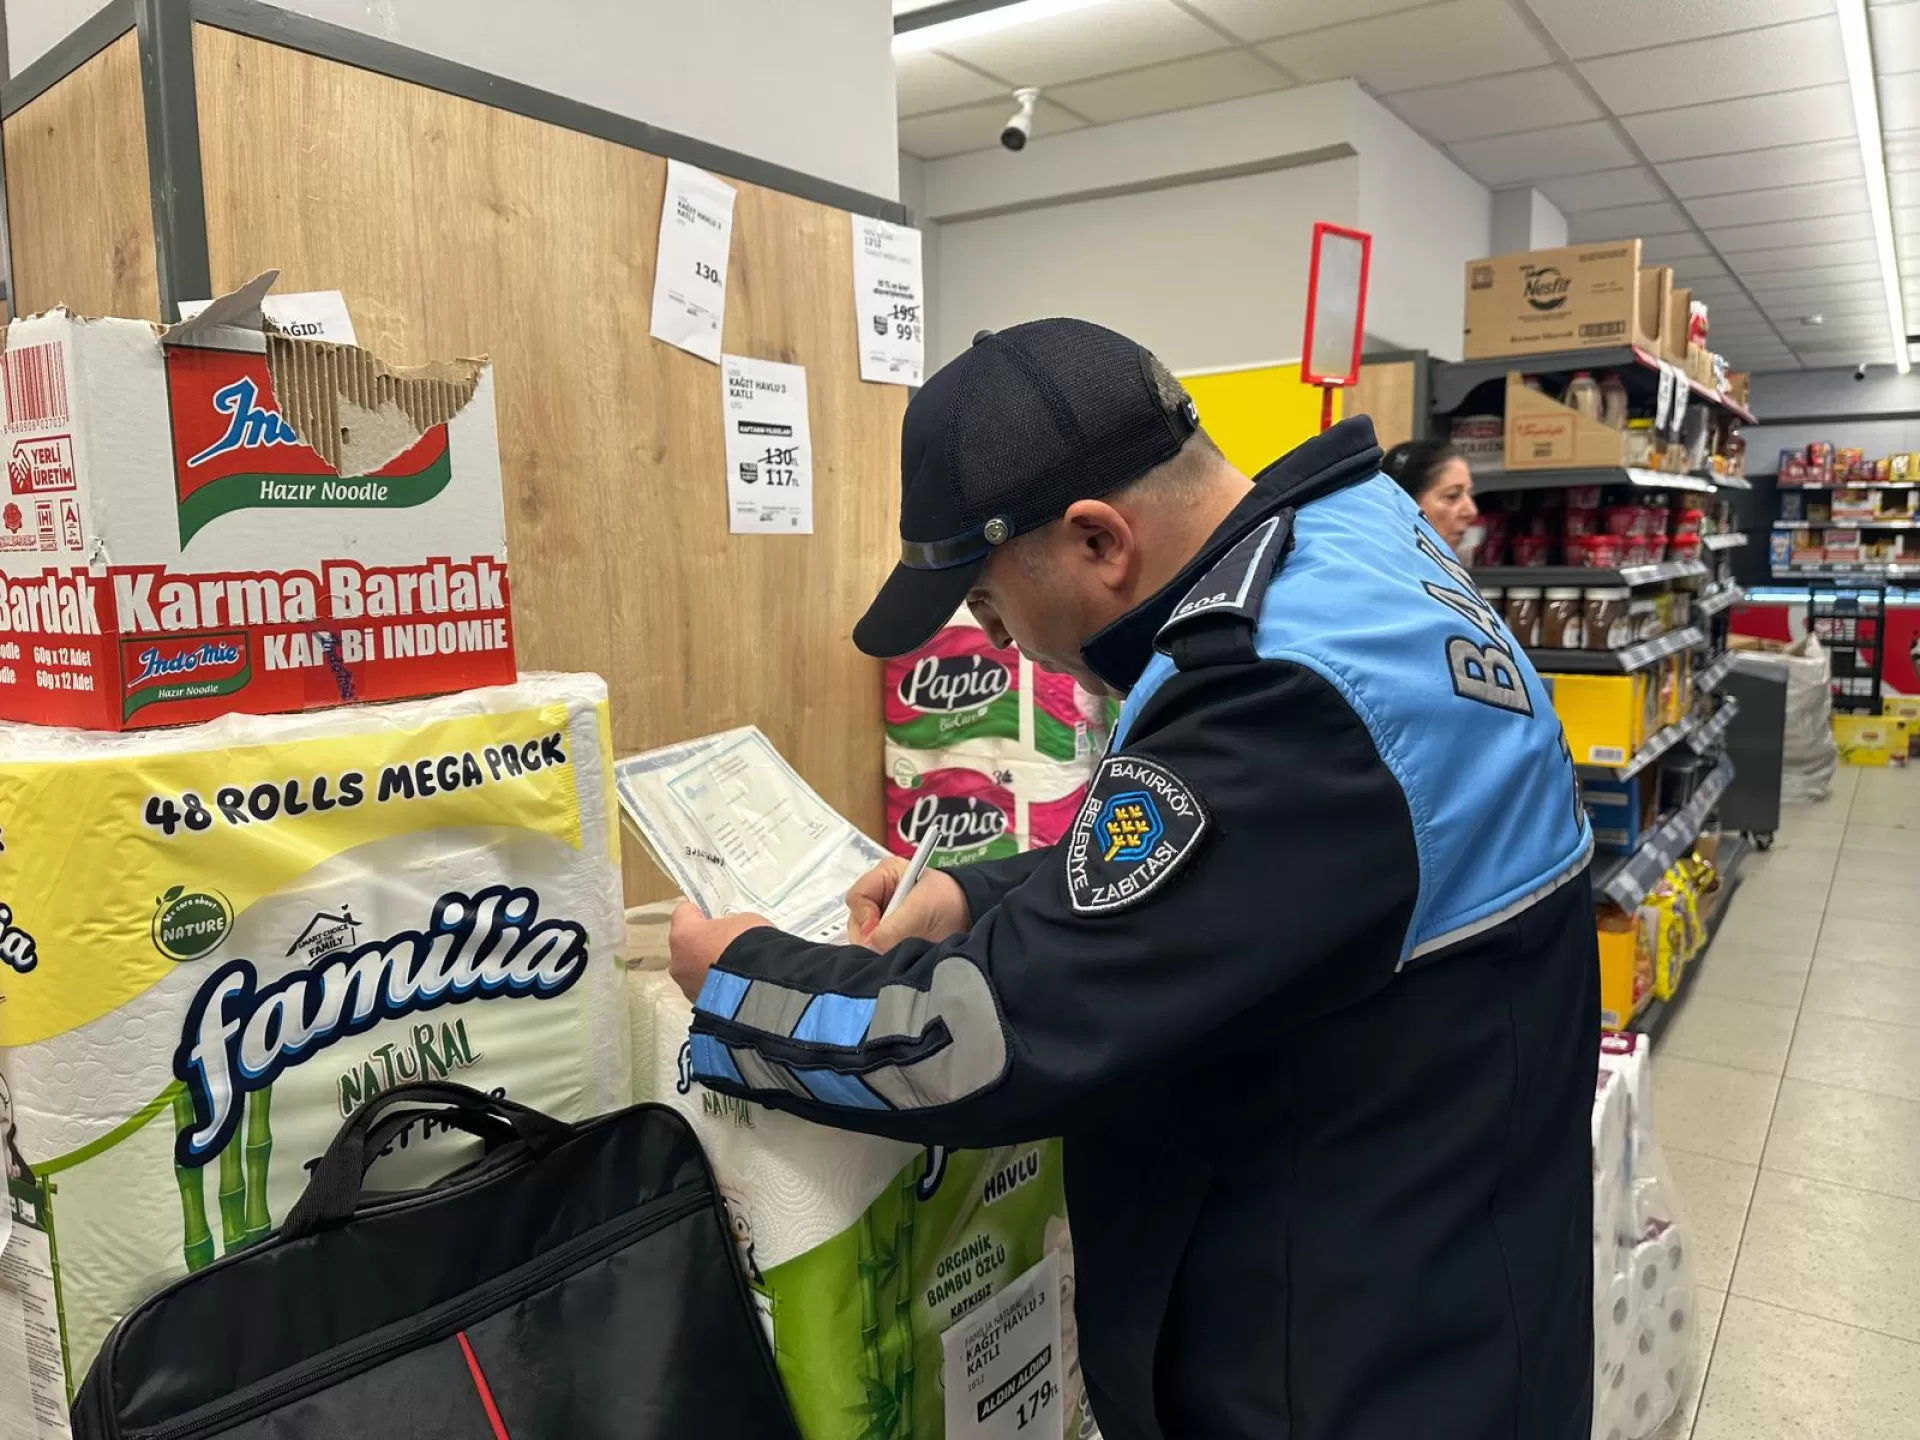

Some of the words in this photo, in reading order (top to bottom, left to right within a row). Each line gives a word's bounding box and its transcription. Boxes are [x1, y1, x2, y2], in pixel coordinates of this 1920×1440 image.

[695, 261, 719, 284] 130
[755, 381, 781, 393] HAVLU
[31, 442, 61, 465] YERLİ
[765, 447, 793, 466] 130
[33, 463, 73, 487] ÜRETİM
[259, 480, 316, 501] Hazır
[321, 481, 389, 502] Noodle
[765, 468, 793, 486] 117
[113, 572, 317, 635] Karma
[329, 561, 506, 621] Bardak
[58, 647, 69, 665] 12
[69, 647, 92, 668] Adet
[61, 672, 71, 689] 12
[72, 673, 94, 692] Adet
[186, 684, 219, 697] Noodle
[907, 654, 1004, 710] Papia
[145, 792, 212, 836] 48
[216, 772, 364, 825] ROLLS
[378, 751, 484, 803] MEGA
[484, 732, 567, 781] PACK
[1109, 762, 1195, 818] BAKIRKÖY
[907, 793, 1001, 847] Papia
[1071, 797, 1103, 891] BELEDİYE
[1091, 840, 1180, 906] ZABITASI
[162, 916, 225, 942] NATURE
[308, 935, 345, 958] FAMILY
[177, 890, 586, 1162] familia
[339, 1018, 483, 1116] NATURAL
[983, 1151, 1039, 1203] HAVLU
[936, 1233, 992, 1279] ORGANİK
[926, 1266, 972, 1308] BAMBU
[975, 1243, 1006, 1279] ÖZLÜ
[950, 1282, 992, 1319] KATKISIZ
[1003, 1297, 1038, 1335] HAVLU
[1038, 1291, 1046, 1306] 3
[966, 1344, 1001, 1378] KATLI
[981, 1379, 1016, 1417] ALDIN
[1016, 1379, 1051, 1431] 179
